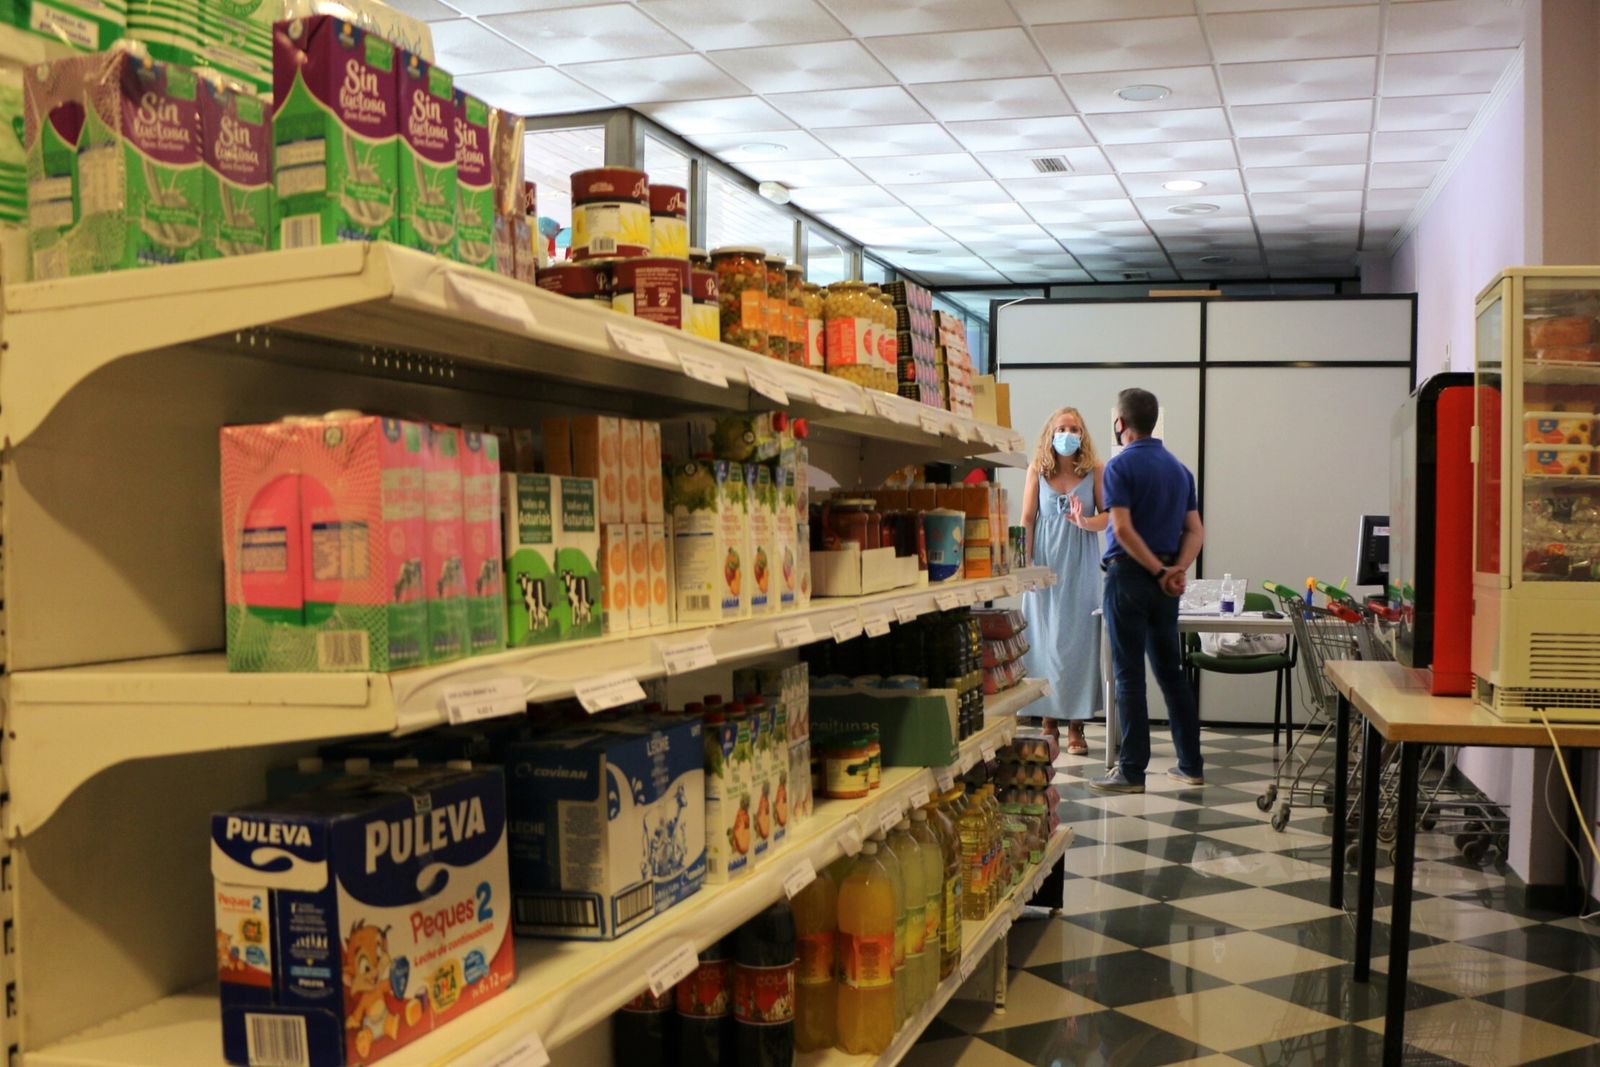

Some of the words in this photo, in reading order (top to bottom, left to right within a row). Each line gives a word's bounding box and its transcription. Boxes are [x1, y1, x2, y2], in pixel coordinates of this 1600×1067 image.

[344, 58, 379, 97] Sin
[138, 91, 180, 126] Sin
[339, 85, 387, 116] lactosa
[412, 89, 442, 124] Sin
[134, 116, 190, 143] lactosa
[219, 115, 251, 148] Sin
[408, 113, 449, 142] lactosa
[454, 117, 478, 149] Sin
[214, 140, 260, 166] lactosa
[519, 511, 551, 526] Asturias
[564, 513, 594, 527] Asturias
[226, 816, 312, 847] PULEVA
[365, 796, 487, 875] PULEVA
[252, 895, 262, 911] 2
[410, 898, 475, 945] Peques
[476, 881, 494, 923] 2
